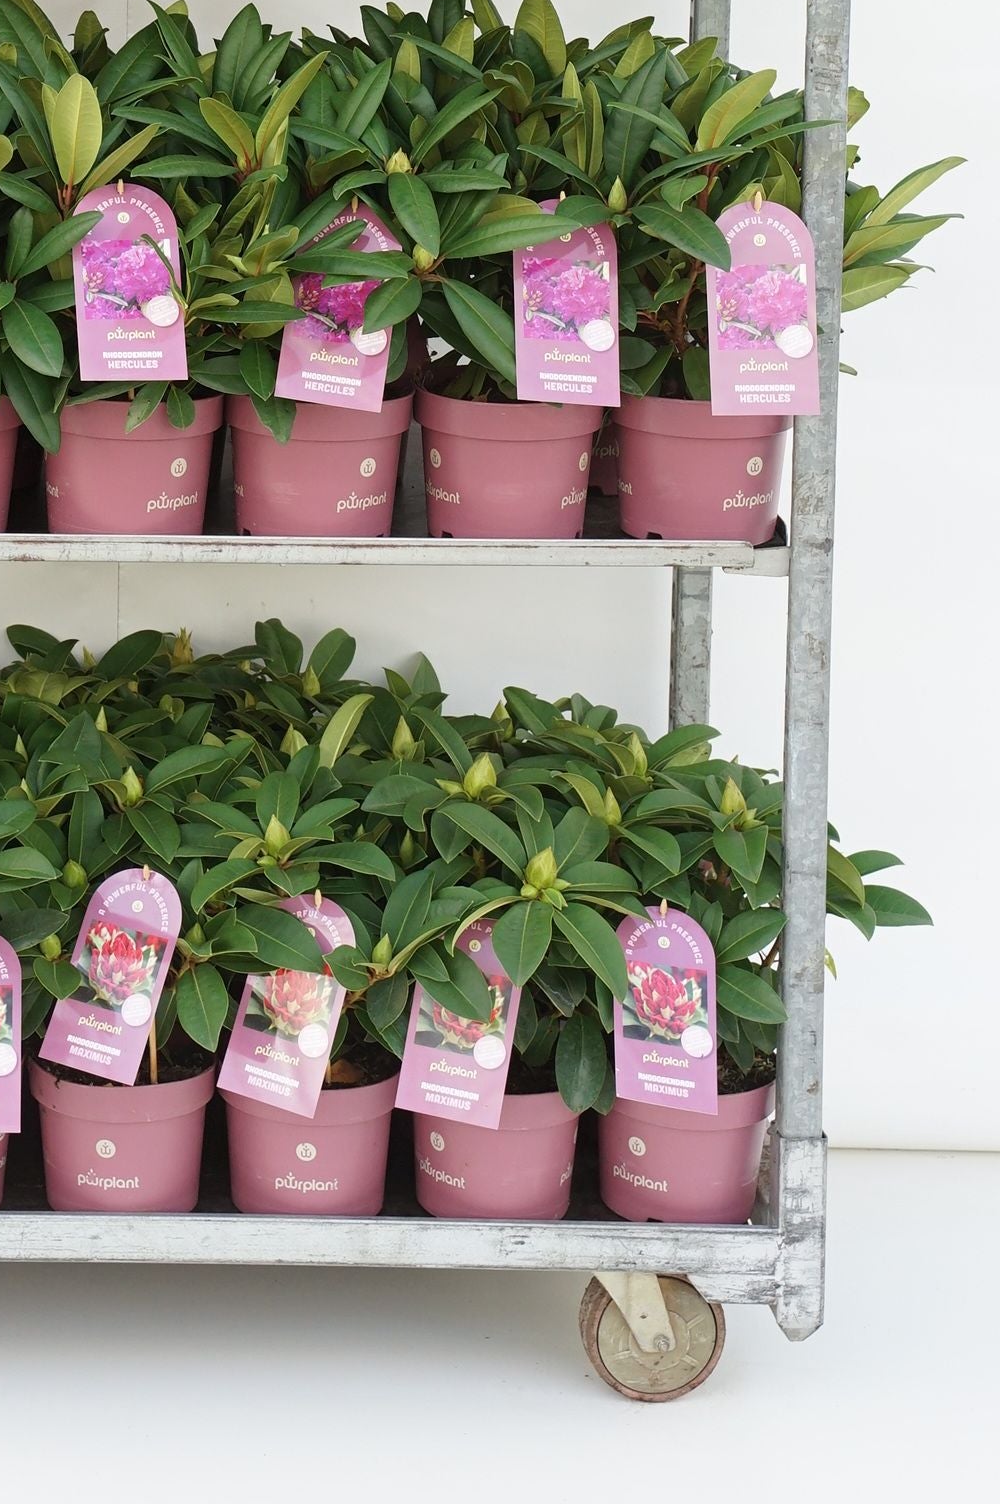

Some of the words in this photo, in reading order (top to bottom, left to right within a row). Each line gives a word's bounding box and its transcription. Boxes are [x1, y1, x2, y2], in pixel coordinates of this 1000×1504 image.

[129, 197, 165, 235] PRESENCE
[766, 218, 802, 259] PRESENCE
[107, 359, 159, 370] HERCULES
[304, 381, 355, 397] HERCULES
[543, 381, 593, 395] HERCULES
[739, 392, 791, 404] HERCULES
[103, 882, 147, 908] POWERFUL
[148, 888, 170, 933] PRESENCE
[671, 923, 704, 965] PRESENCE
[69, 1045, 114, 1066] MAXIMUS
[247, 1075, 292, 1098] MAXIMUS
[643, 1080, 689, 1099] MAXIMUS
[425, 1092, 471, 1112] MAXIMUS
